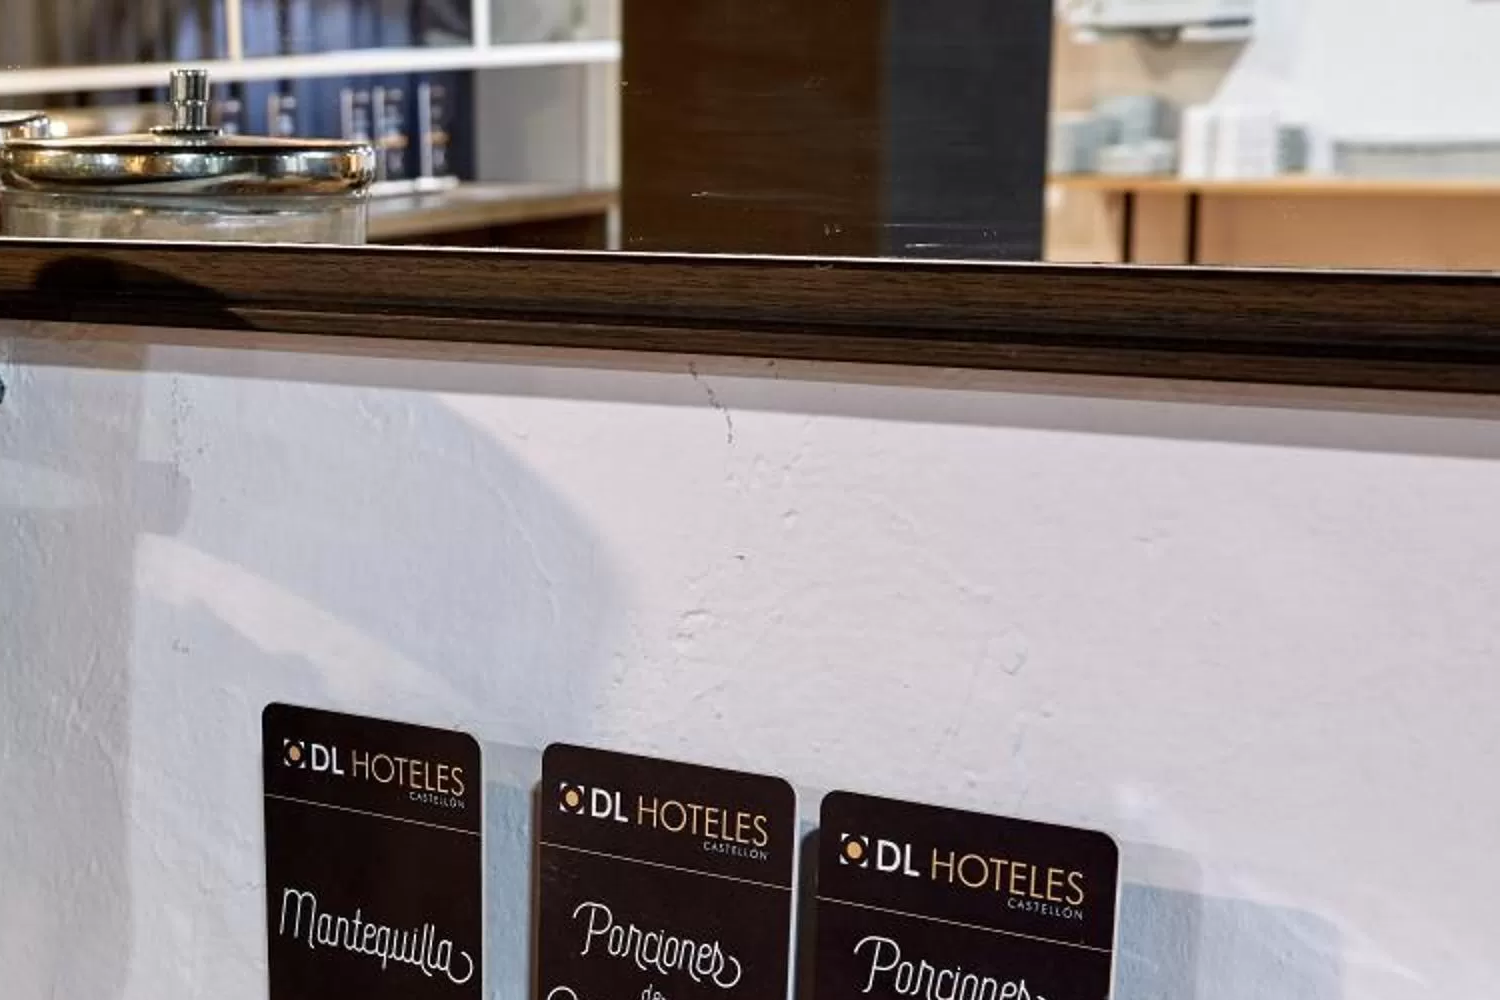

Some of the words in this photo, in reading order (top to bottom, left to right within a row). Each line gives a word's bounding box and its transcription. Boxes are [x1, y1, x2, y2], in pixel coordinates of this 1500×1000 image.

[311, 743, 345, 775] DL
[352, 750, 465, 797] HOTELES
[590, 787, 629, 823] DL
[637, 795, 769, 847] HOTELES
[875, 838, 921, 878] DL
[930, 847, 1086, 907] HOTELES
[279, 888, 475, 984] Mantequilla
[572, 901, 742, 989] Porciones
